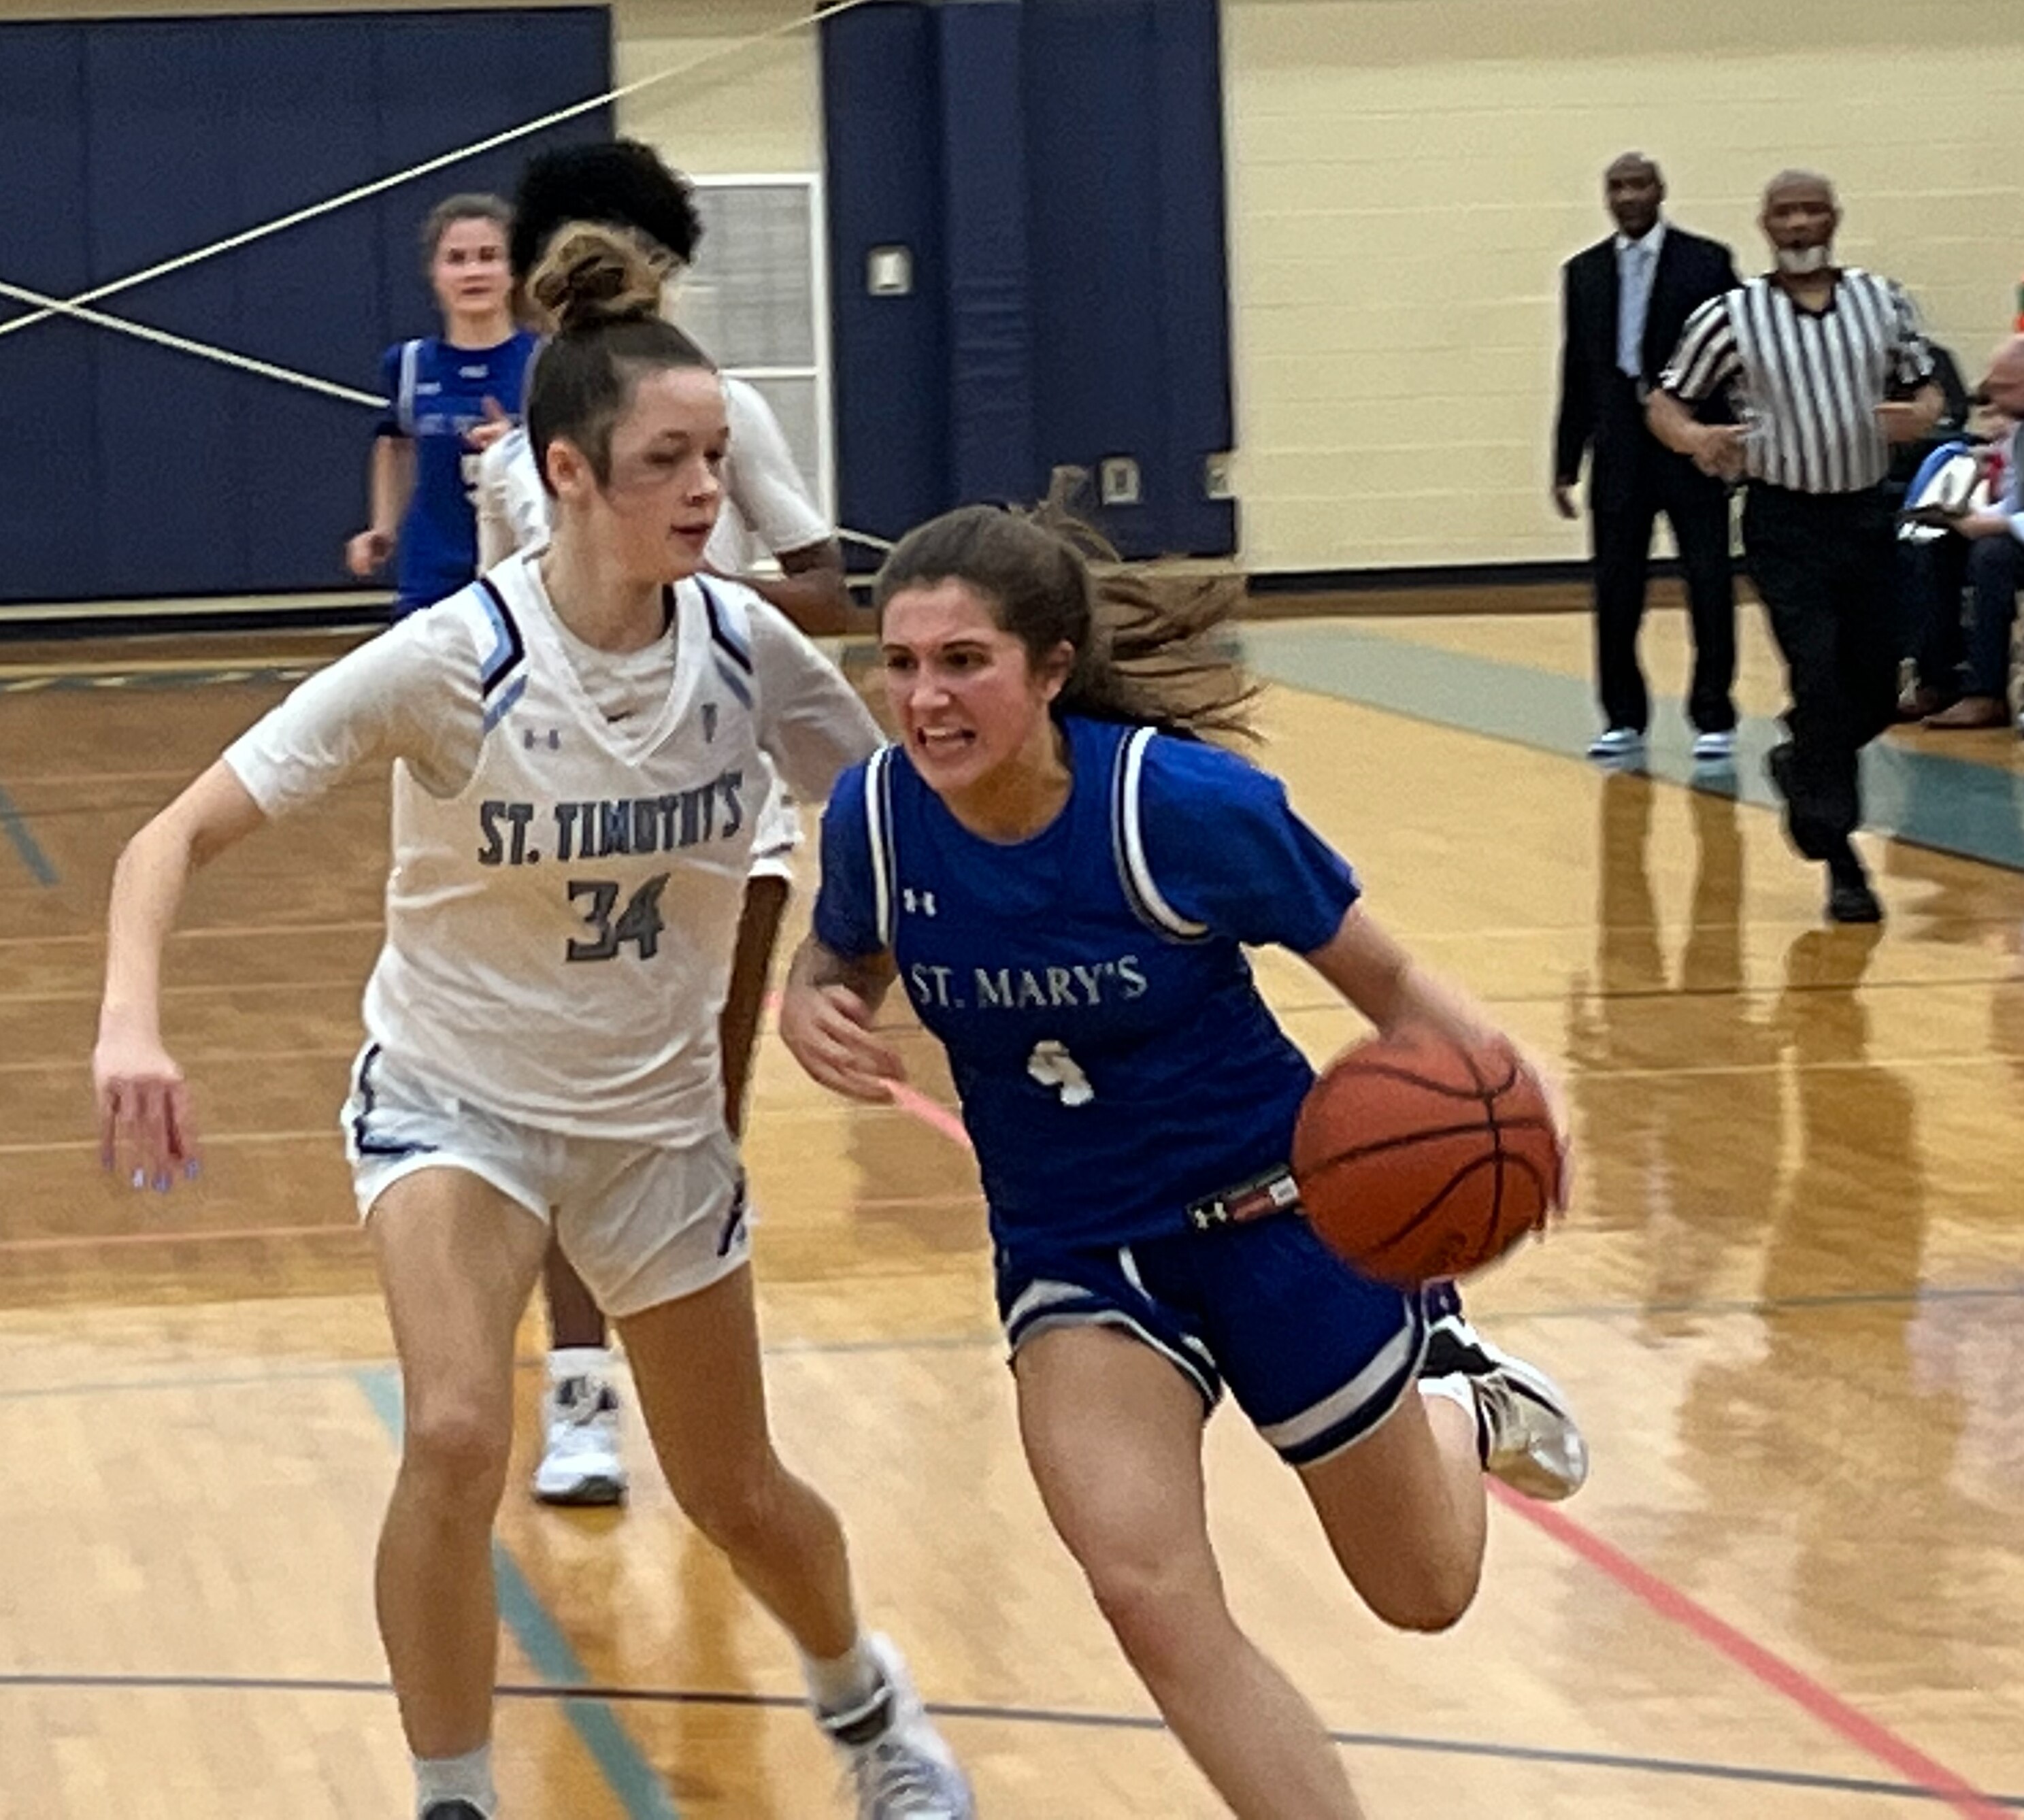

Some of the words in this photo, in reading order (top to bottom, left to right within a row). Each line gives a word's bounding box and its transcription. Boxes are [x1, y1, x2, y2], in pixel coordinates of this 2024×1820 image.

[478, 799, 541, 865] ST.
[565, 872, 671, 963] 34
[910, 962, 966, 1009] ST.
[974, 954, 1148, 1009] MARY'S
